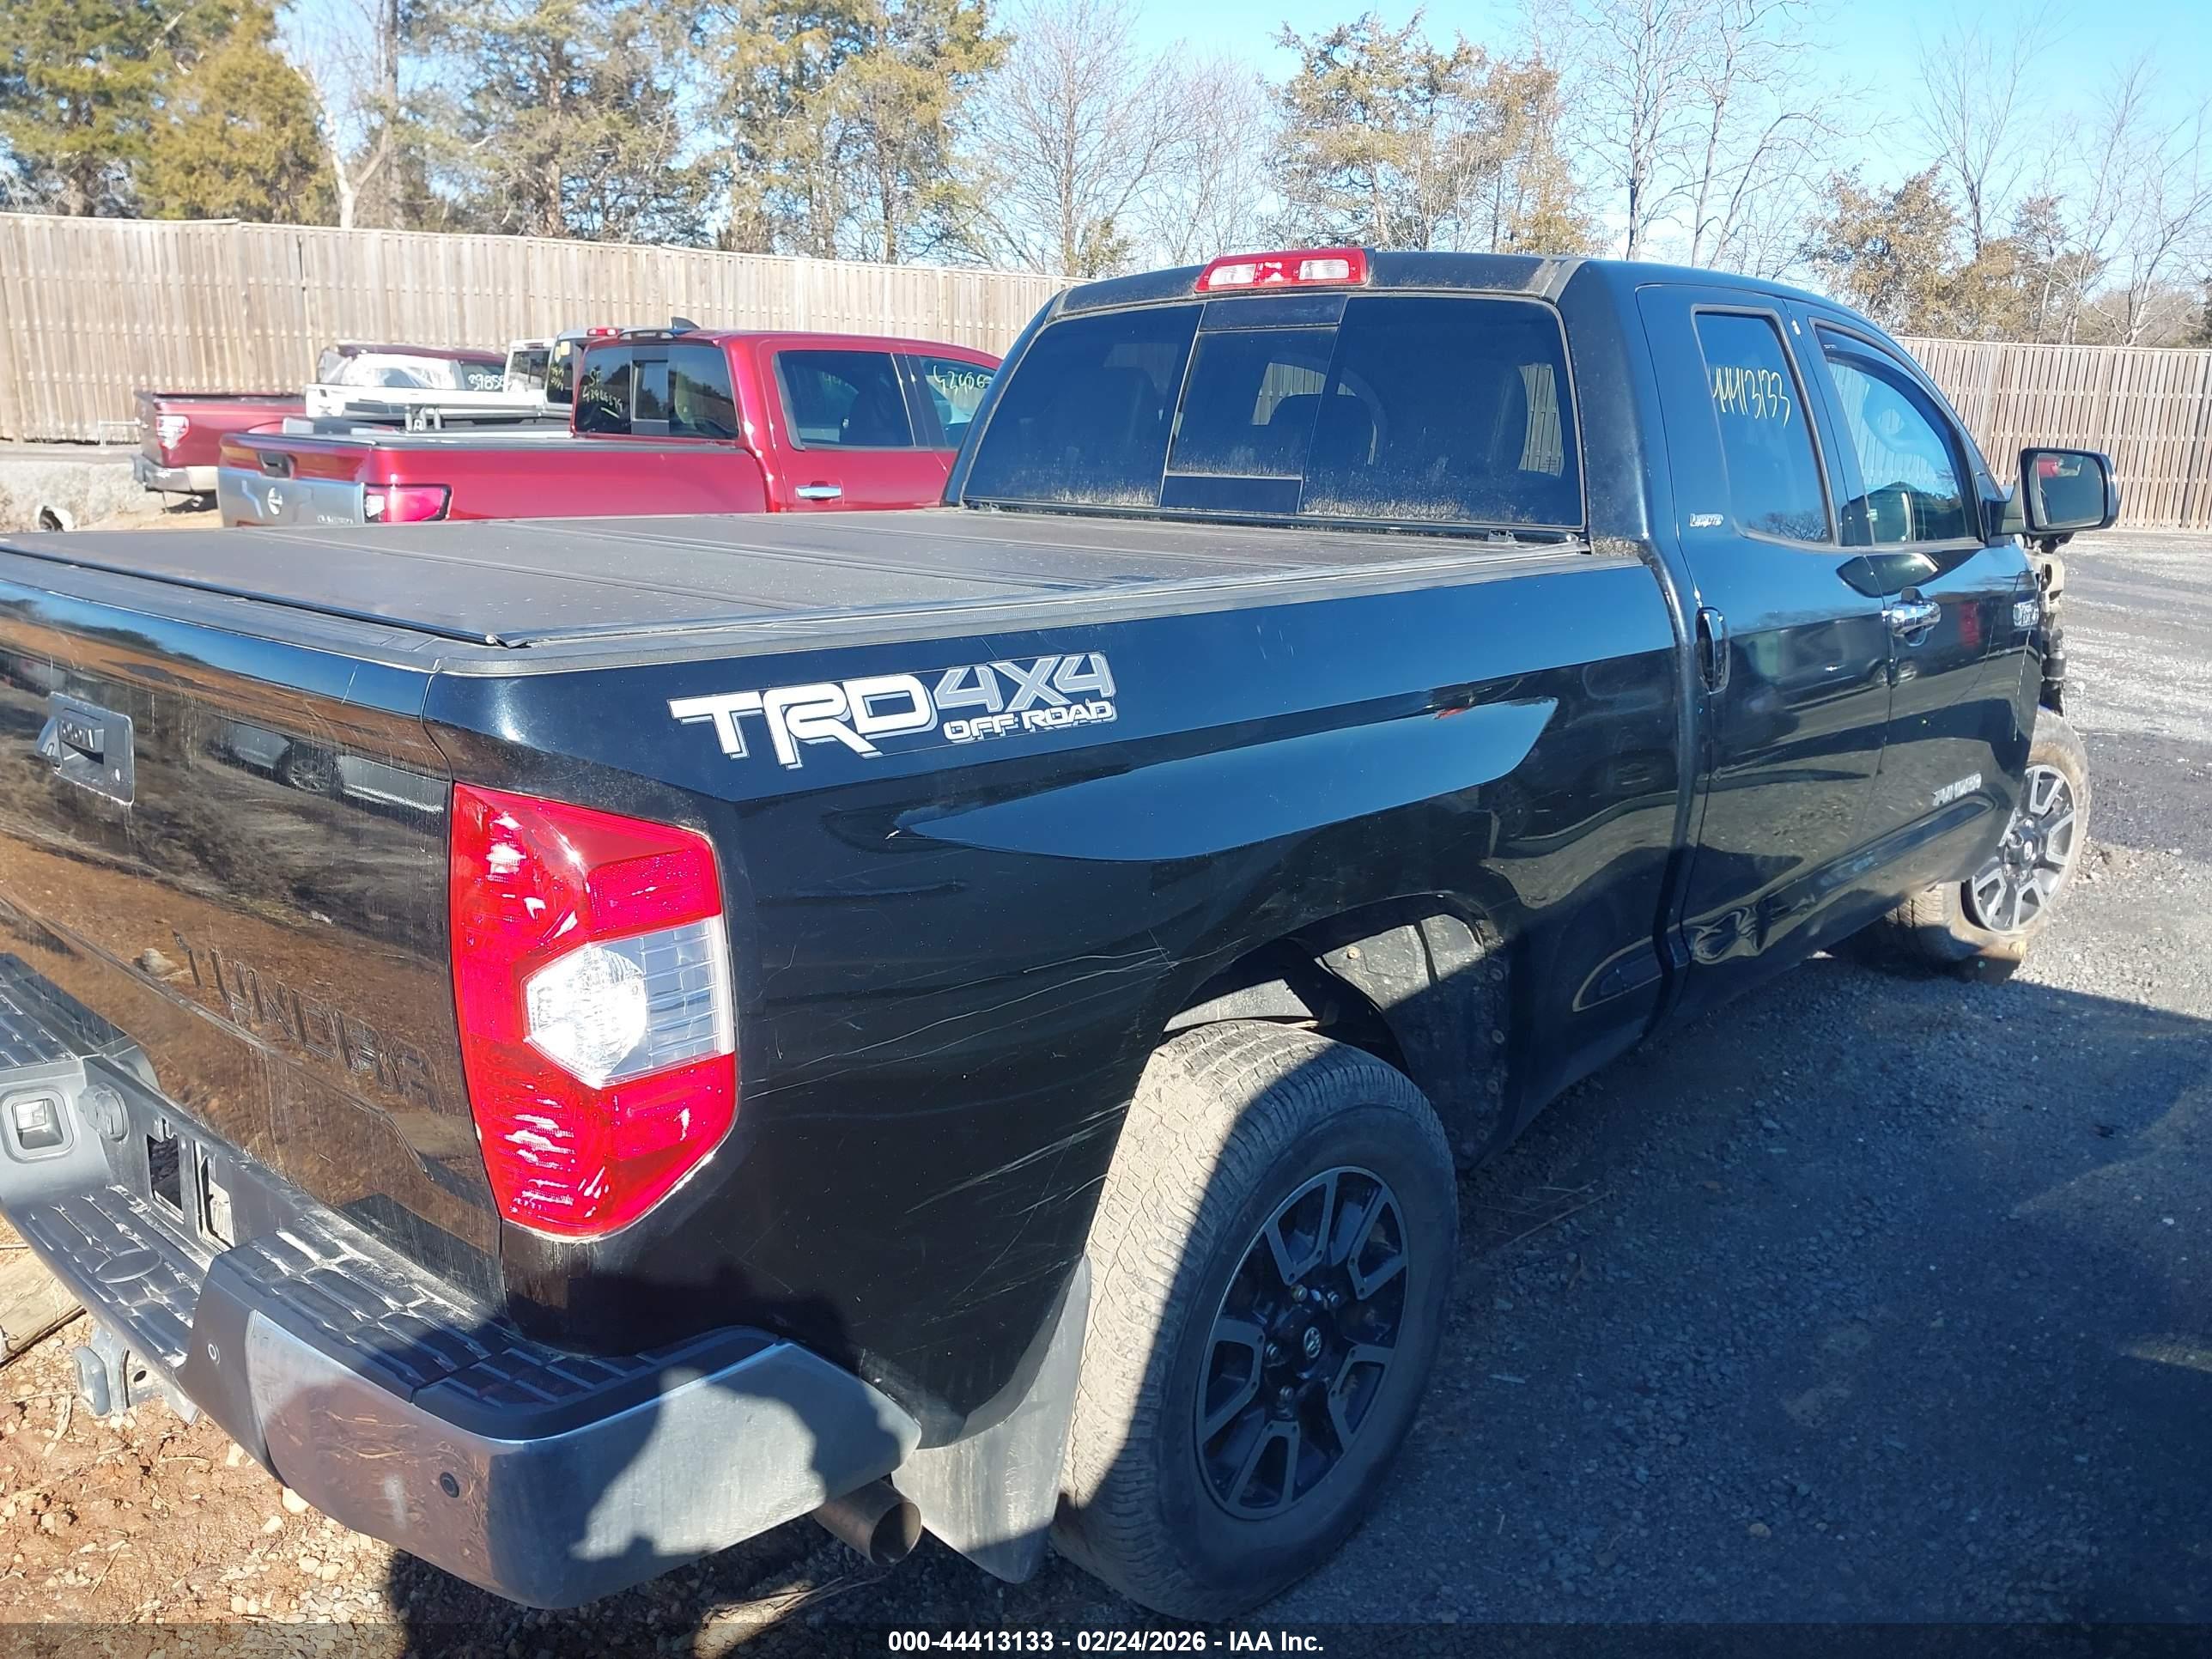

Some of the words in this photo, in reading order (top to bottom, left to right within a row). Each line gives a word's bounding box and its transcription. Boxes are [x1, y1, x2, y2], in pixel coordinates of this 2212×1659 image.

[666, 673, 938, 769] TRD
[943, 709, 1019, 744] OFF
[1023, 698, 1116, 732] ROAD
